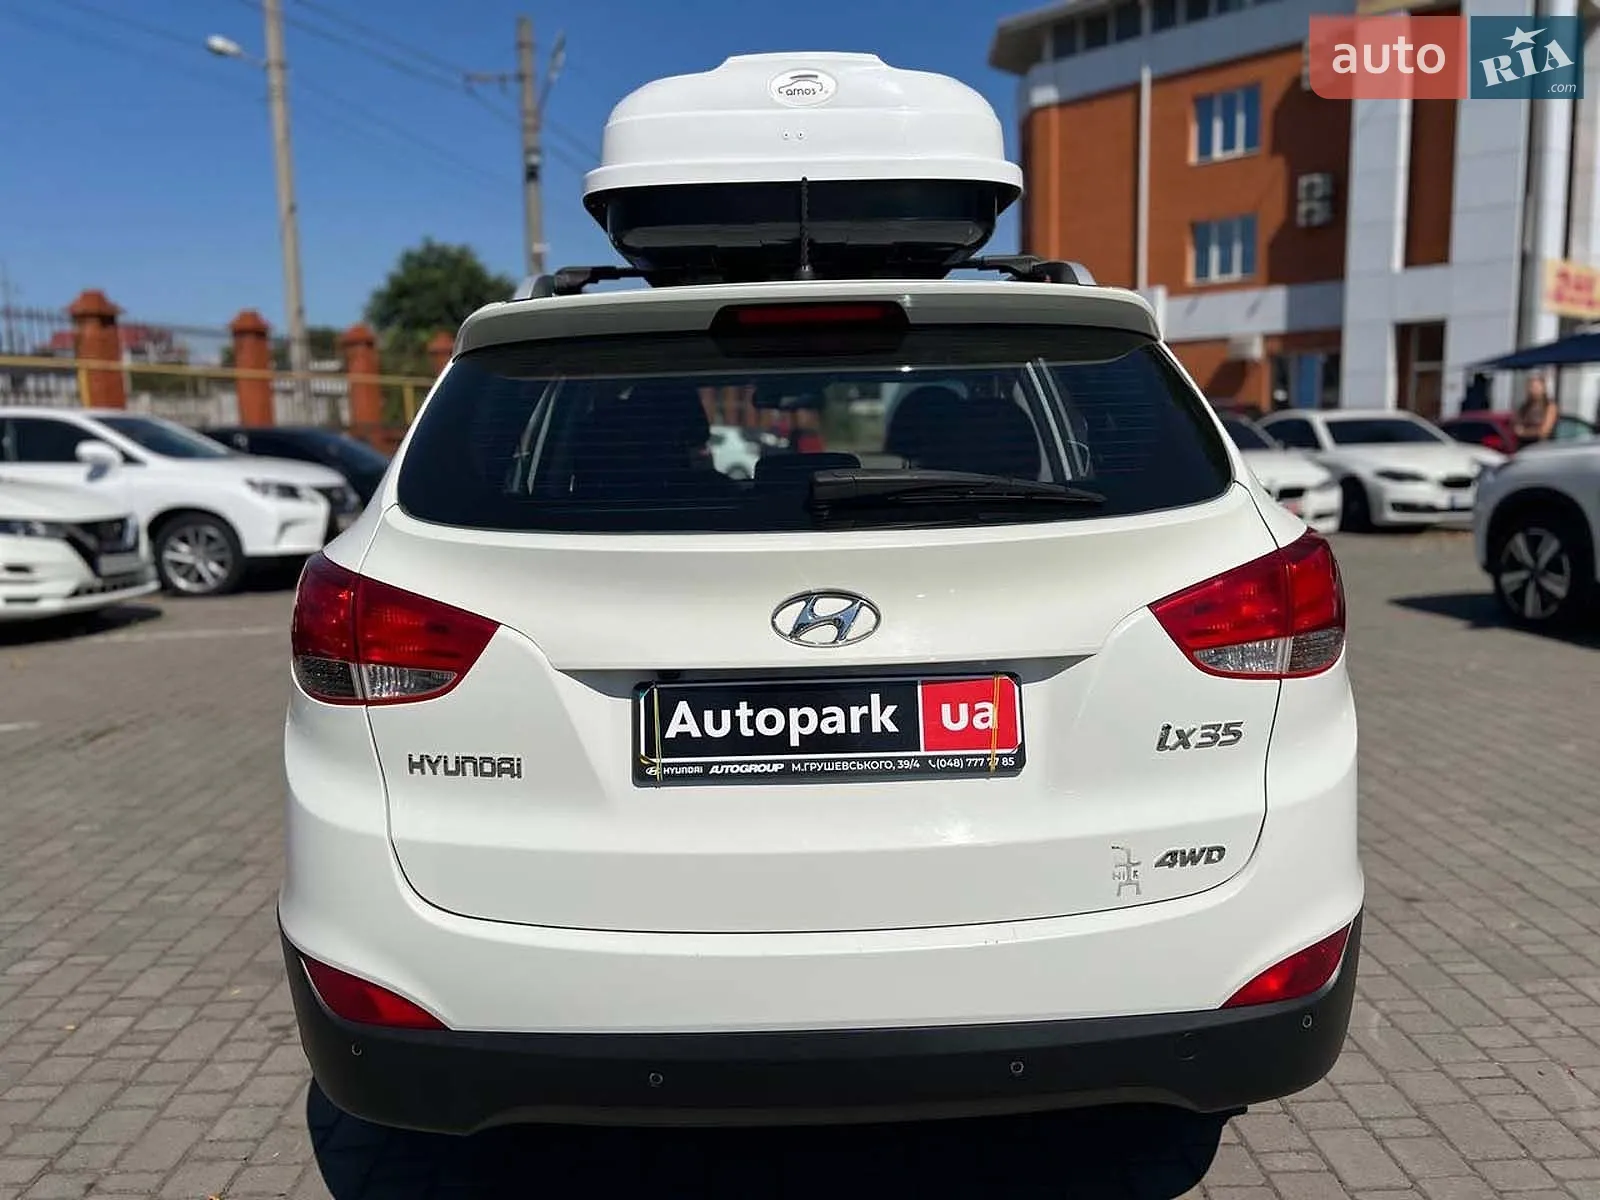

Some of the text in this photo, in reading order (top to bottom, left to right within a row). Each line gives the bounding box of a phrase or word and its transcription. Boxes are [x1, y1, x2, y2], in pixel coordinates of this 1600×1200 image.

[785, 88, 817, 96] amos
[664, 693, 998, 747] Autopark ua
[1156, 721, 1244, 752] ix35
[407, 753, 523, 779] HYUNDAI
[663, 765, 704, 775] HYUNDAI
[708, 763, 785, 775] AUTOGROUP
[896, 758, 921, 770] 39/4
[936, 758, 964, 770] (048)
[965, 757, 985, 767] 777
[1001, 756, 1015, 766] 85
[1154, 845, 1226, 868] 4WD
